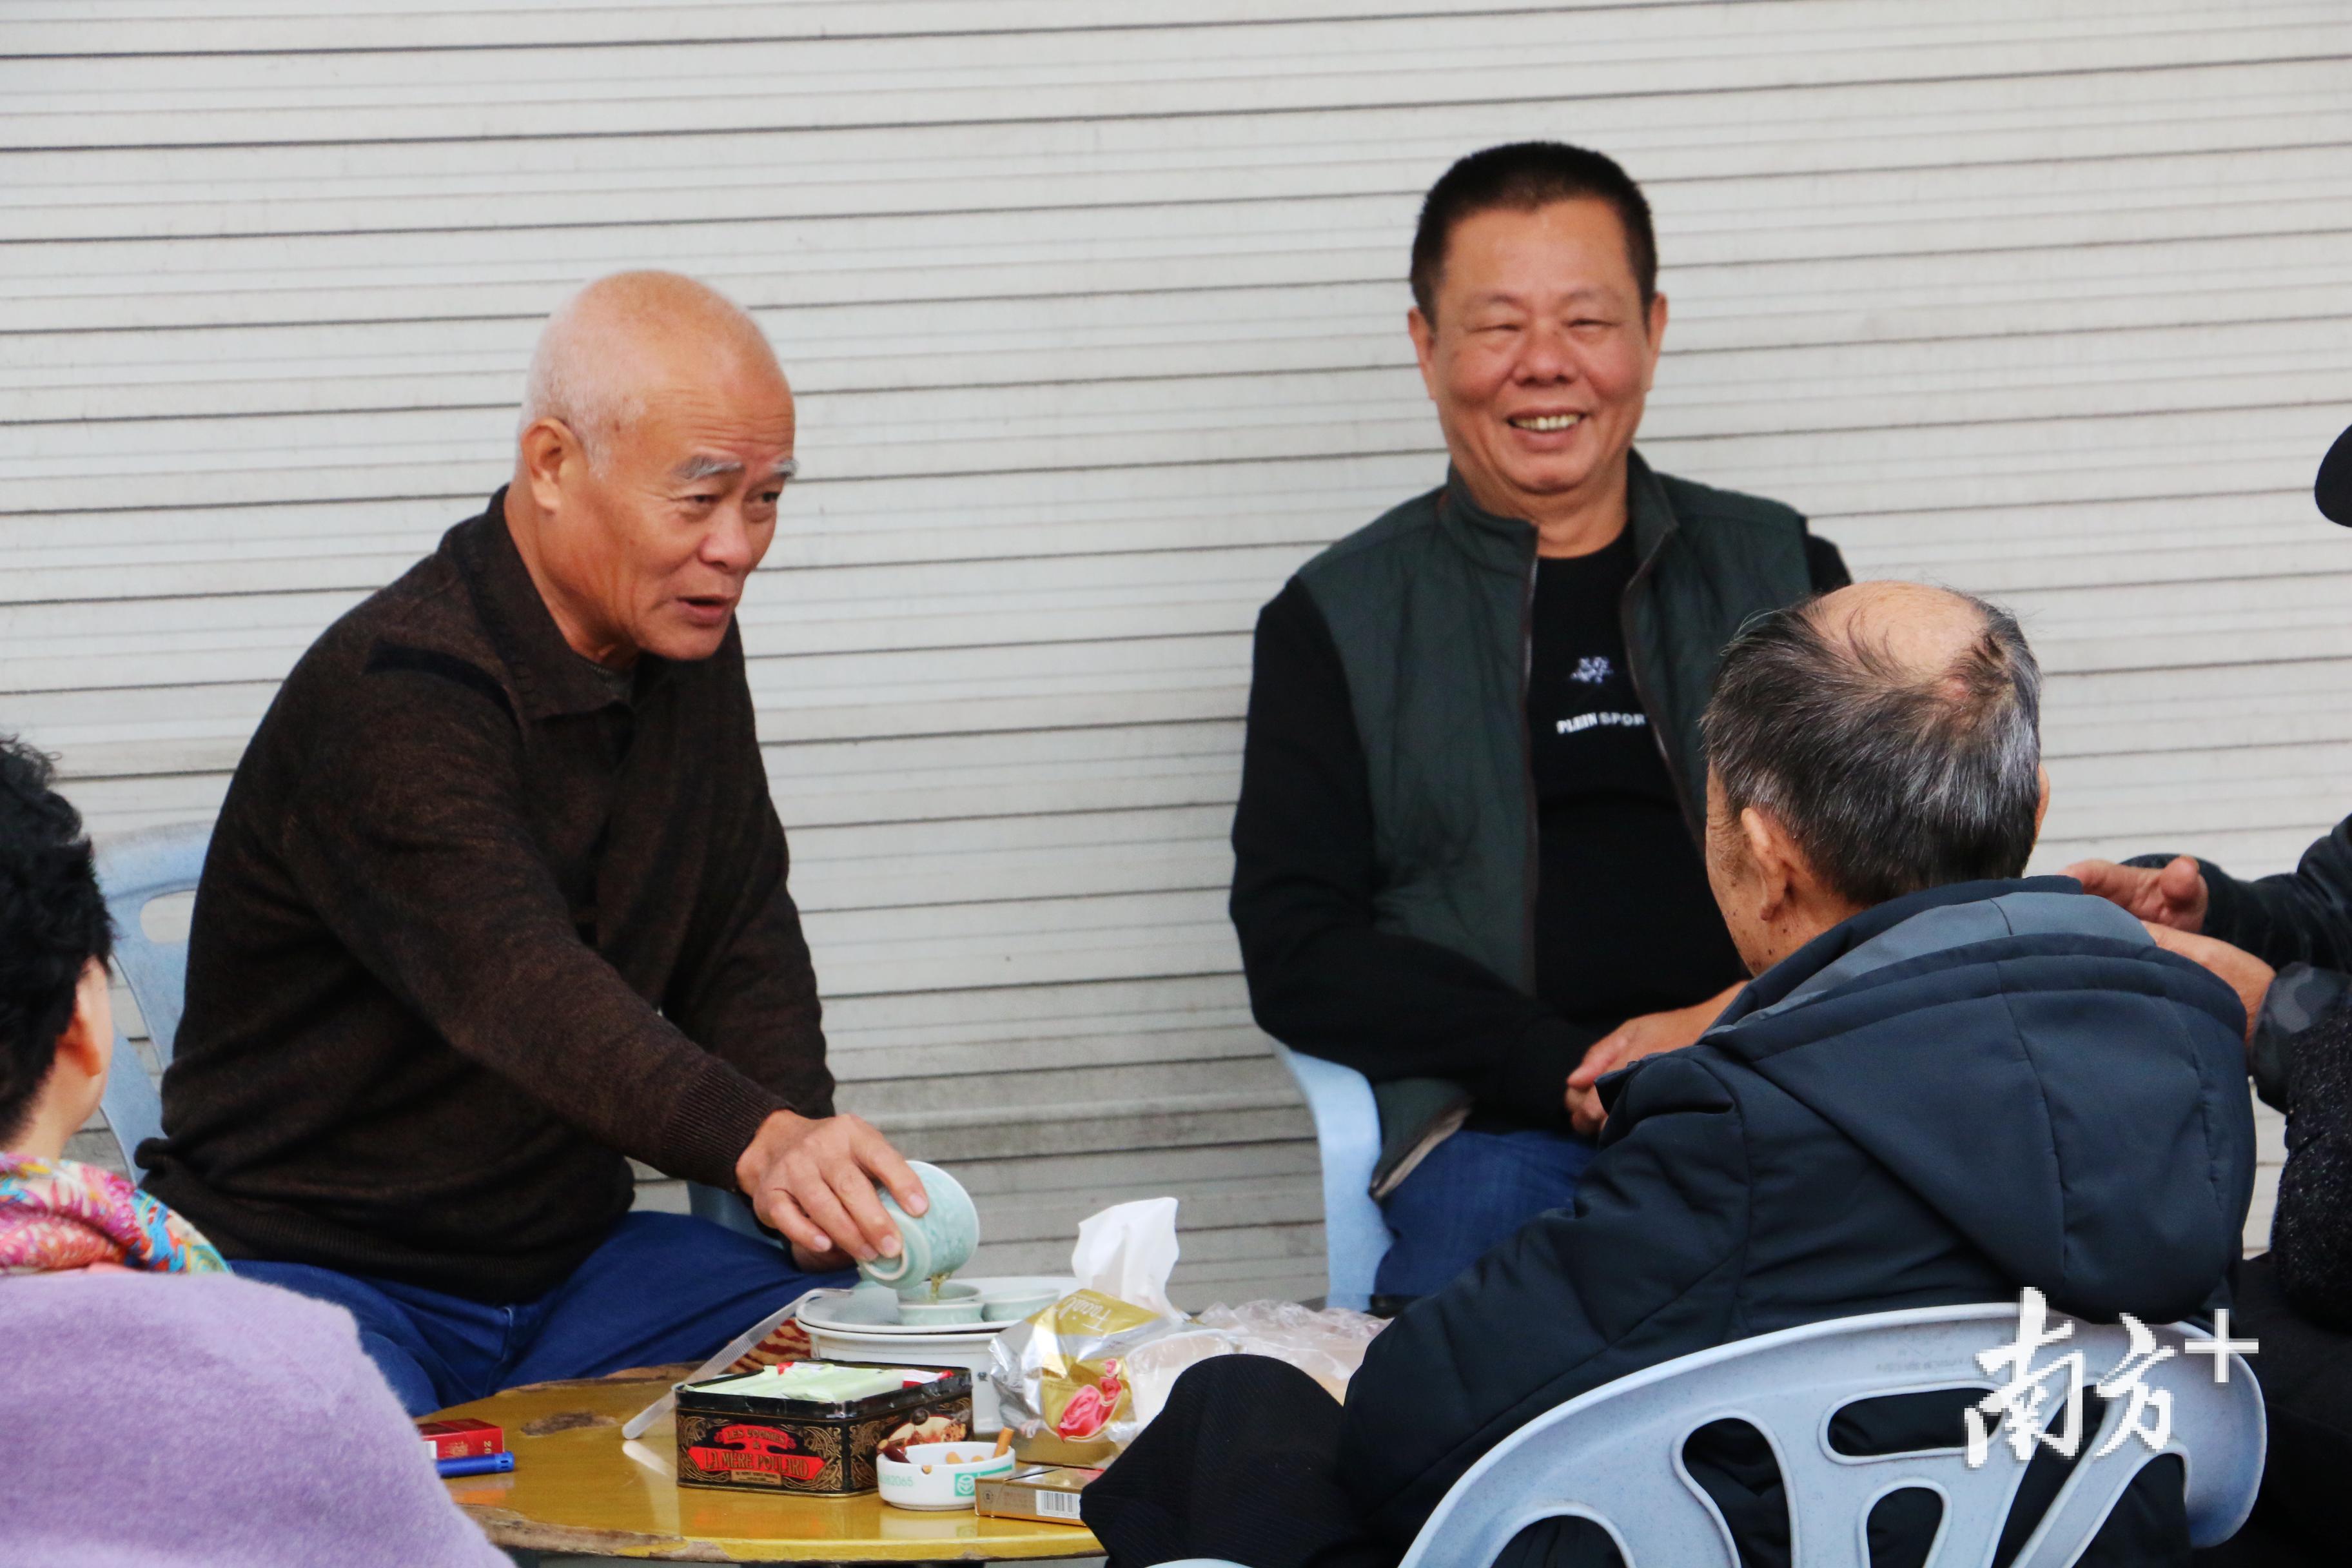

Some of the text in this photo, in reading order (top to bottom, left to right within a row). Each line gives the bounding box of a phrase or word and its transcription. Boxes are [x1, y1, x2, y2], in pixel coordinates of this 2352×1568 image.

[1599, 712, 1645, 727] SPOR
[727, 1429, 743, 1440] LES
[705, 1450, 720, 1469] LA
[758, 1455, 808, 1477] POULARD
